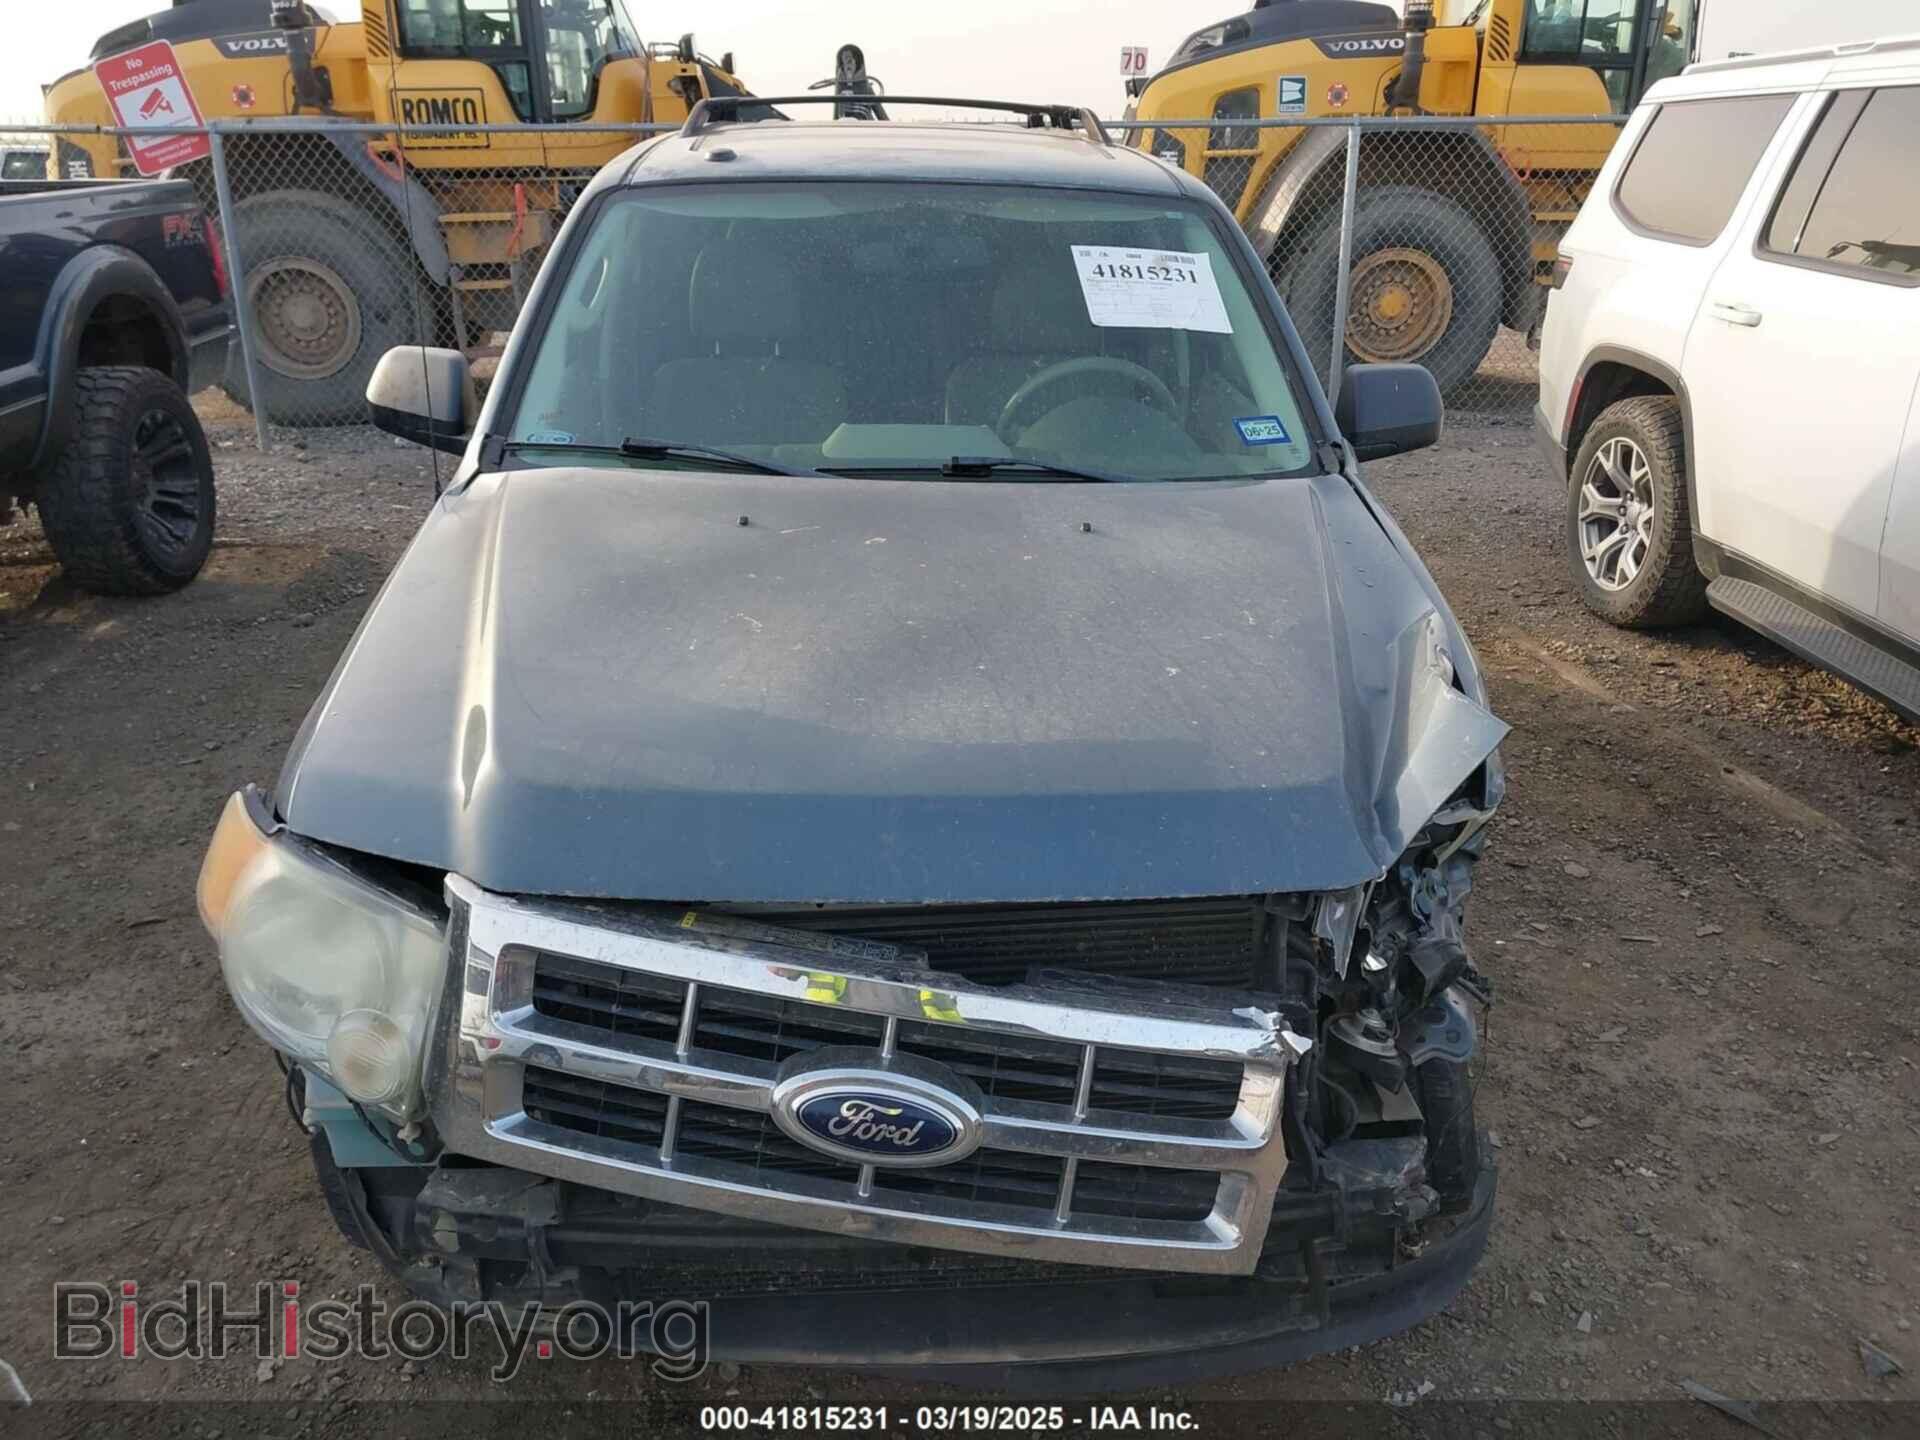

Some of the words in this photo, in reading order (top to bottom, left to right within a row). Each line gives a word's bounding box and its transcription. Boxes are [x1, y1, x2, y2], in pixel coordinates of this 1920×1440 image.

[226, 36, 289, 52] VOLV
[1327, 38, 1405, 52] VOLVO
[125, 58, 144, 71] No
[1122, 52, 1146, 71] 70
[108, 63, 174, 92] Trespassing
[401, 97, 478, 125] ROMCO
[1092, 263, 1198, 284] 41815231
[827, 1099, 926, 1147] Ford
